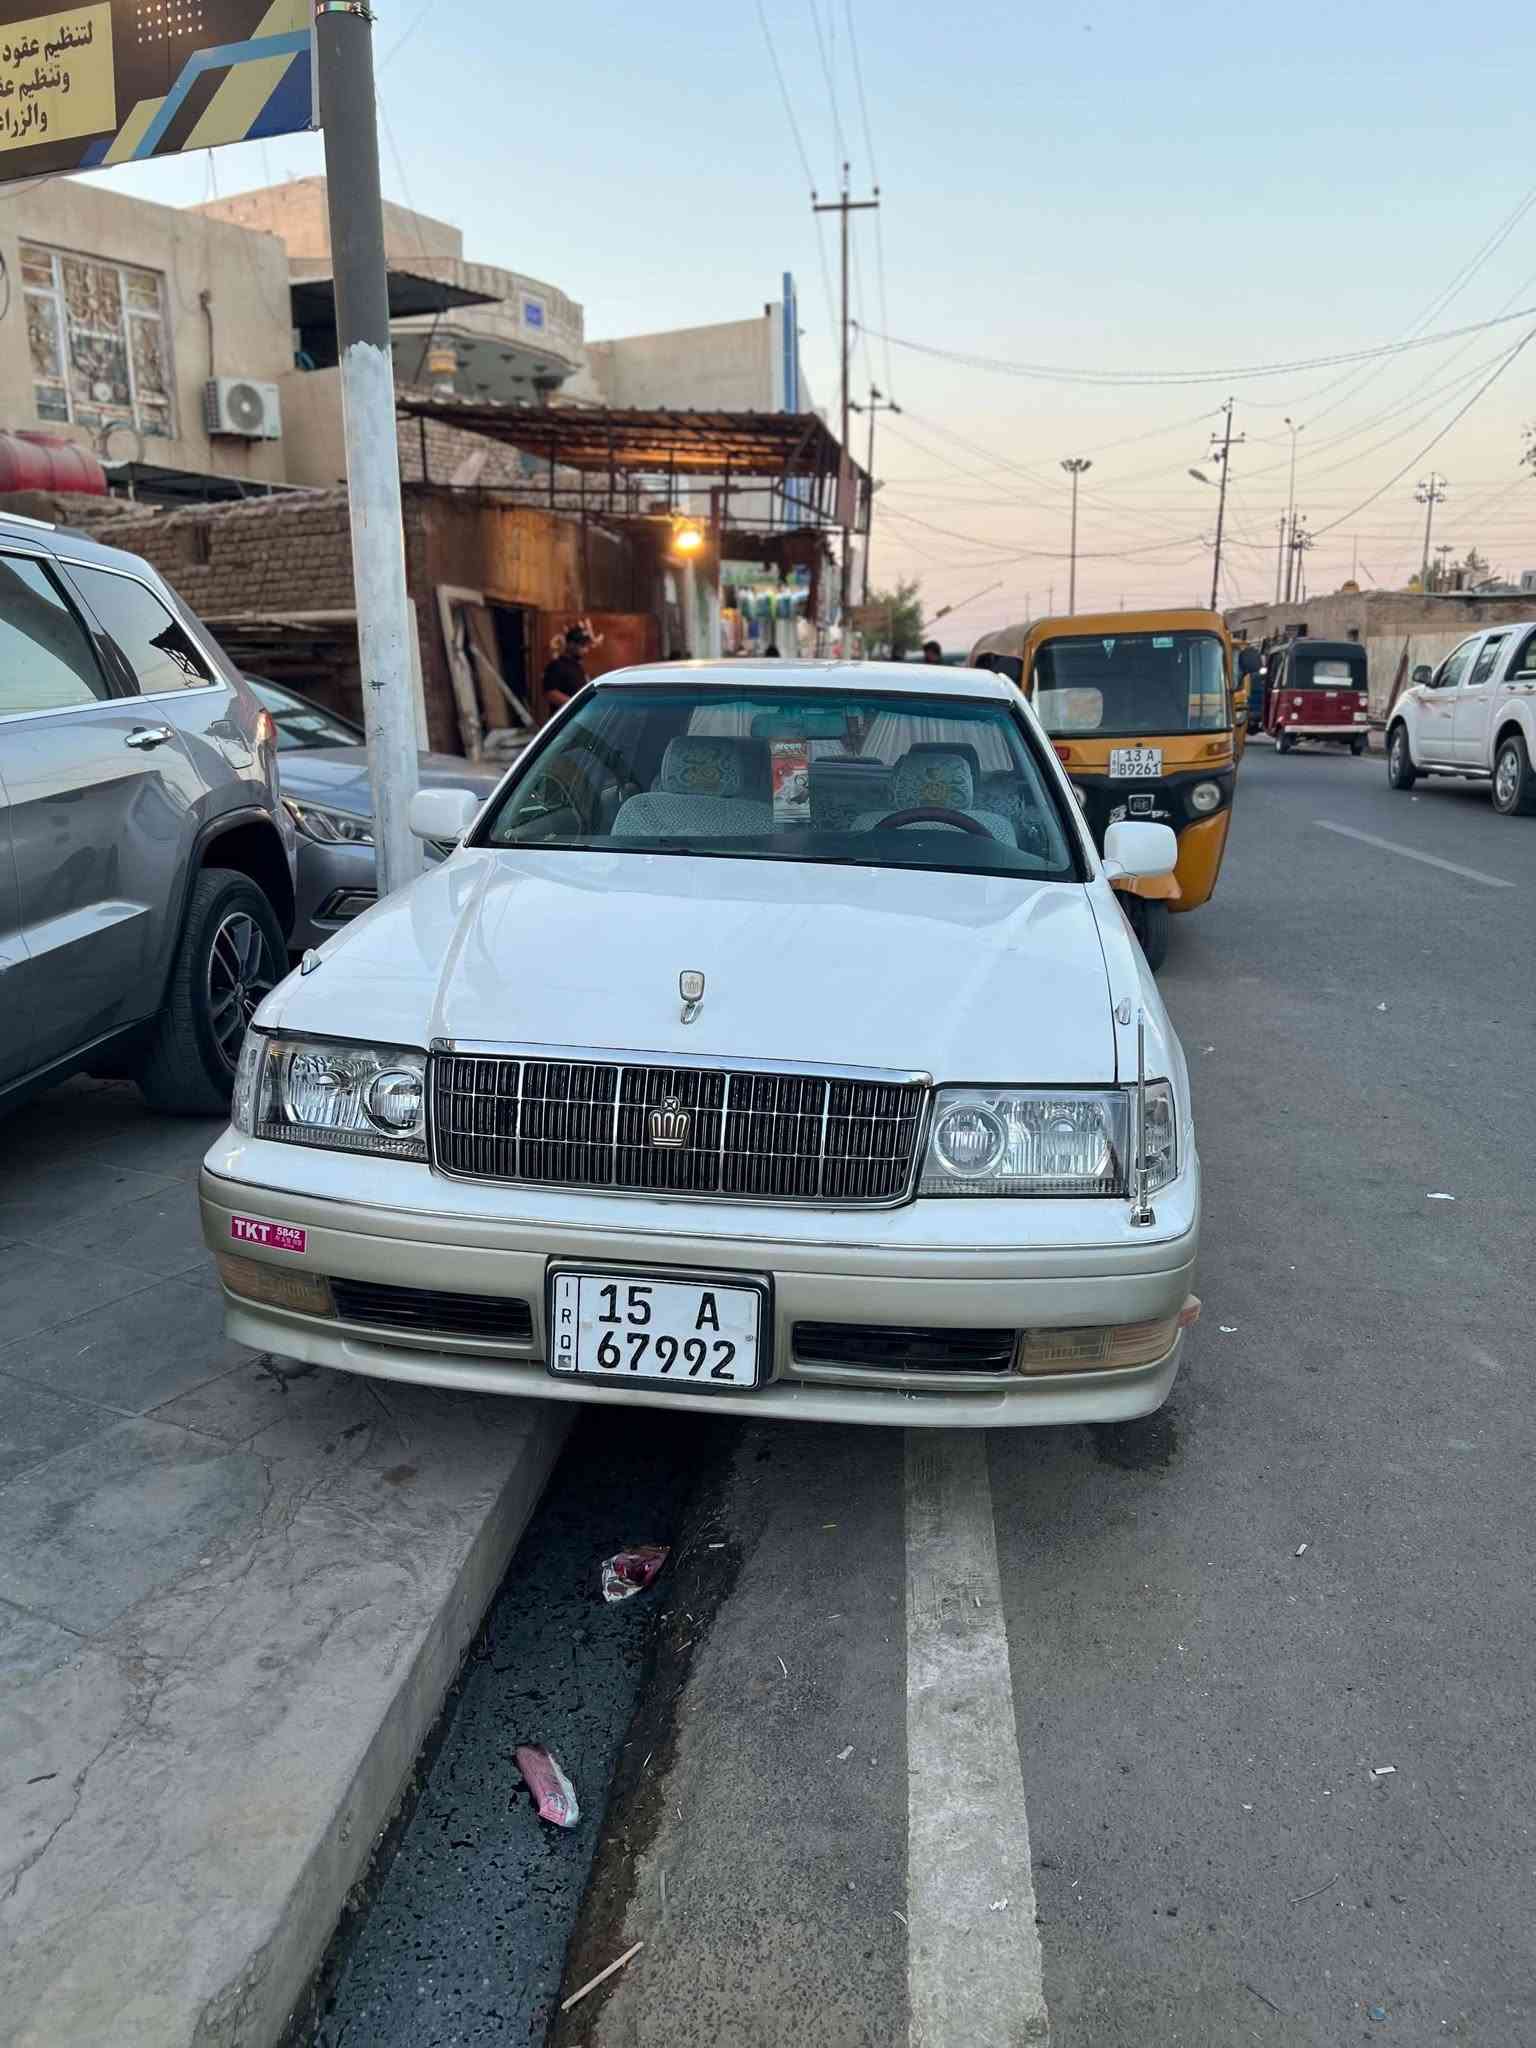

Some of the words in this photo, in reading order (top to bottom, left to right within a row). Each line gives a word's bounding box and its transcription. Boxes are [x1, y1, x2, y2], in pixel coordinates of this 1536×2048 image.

[2, 36, 39, 69] عقود
[44, 20, 93, 63] لتنظيم
[19, 64, 70, 102] وتنظيم
[1120, 762, 1159, 776] 89261
[1125, 750, 1141, 762] 13
[1146, 750, 1154, 761] A
[234, 1219, 270, 1242] TKT
[276, 1226, 300, 1240] 5842
[598, 1284, 652, 1326] 15
[695, 1292, 720, 1331] A
[597, 1331, 736, 1380] 67992
